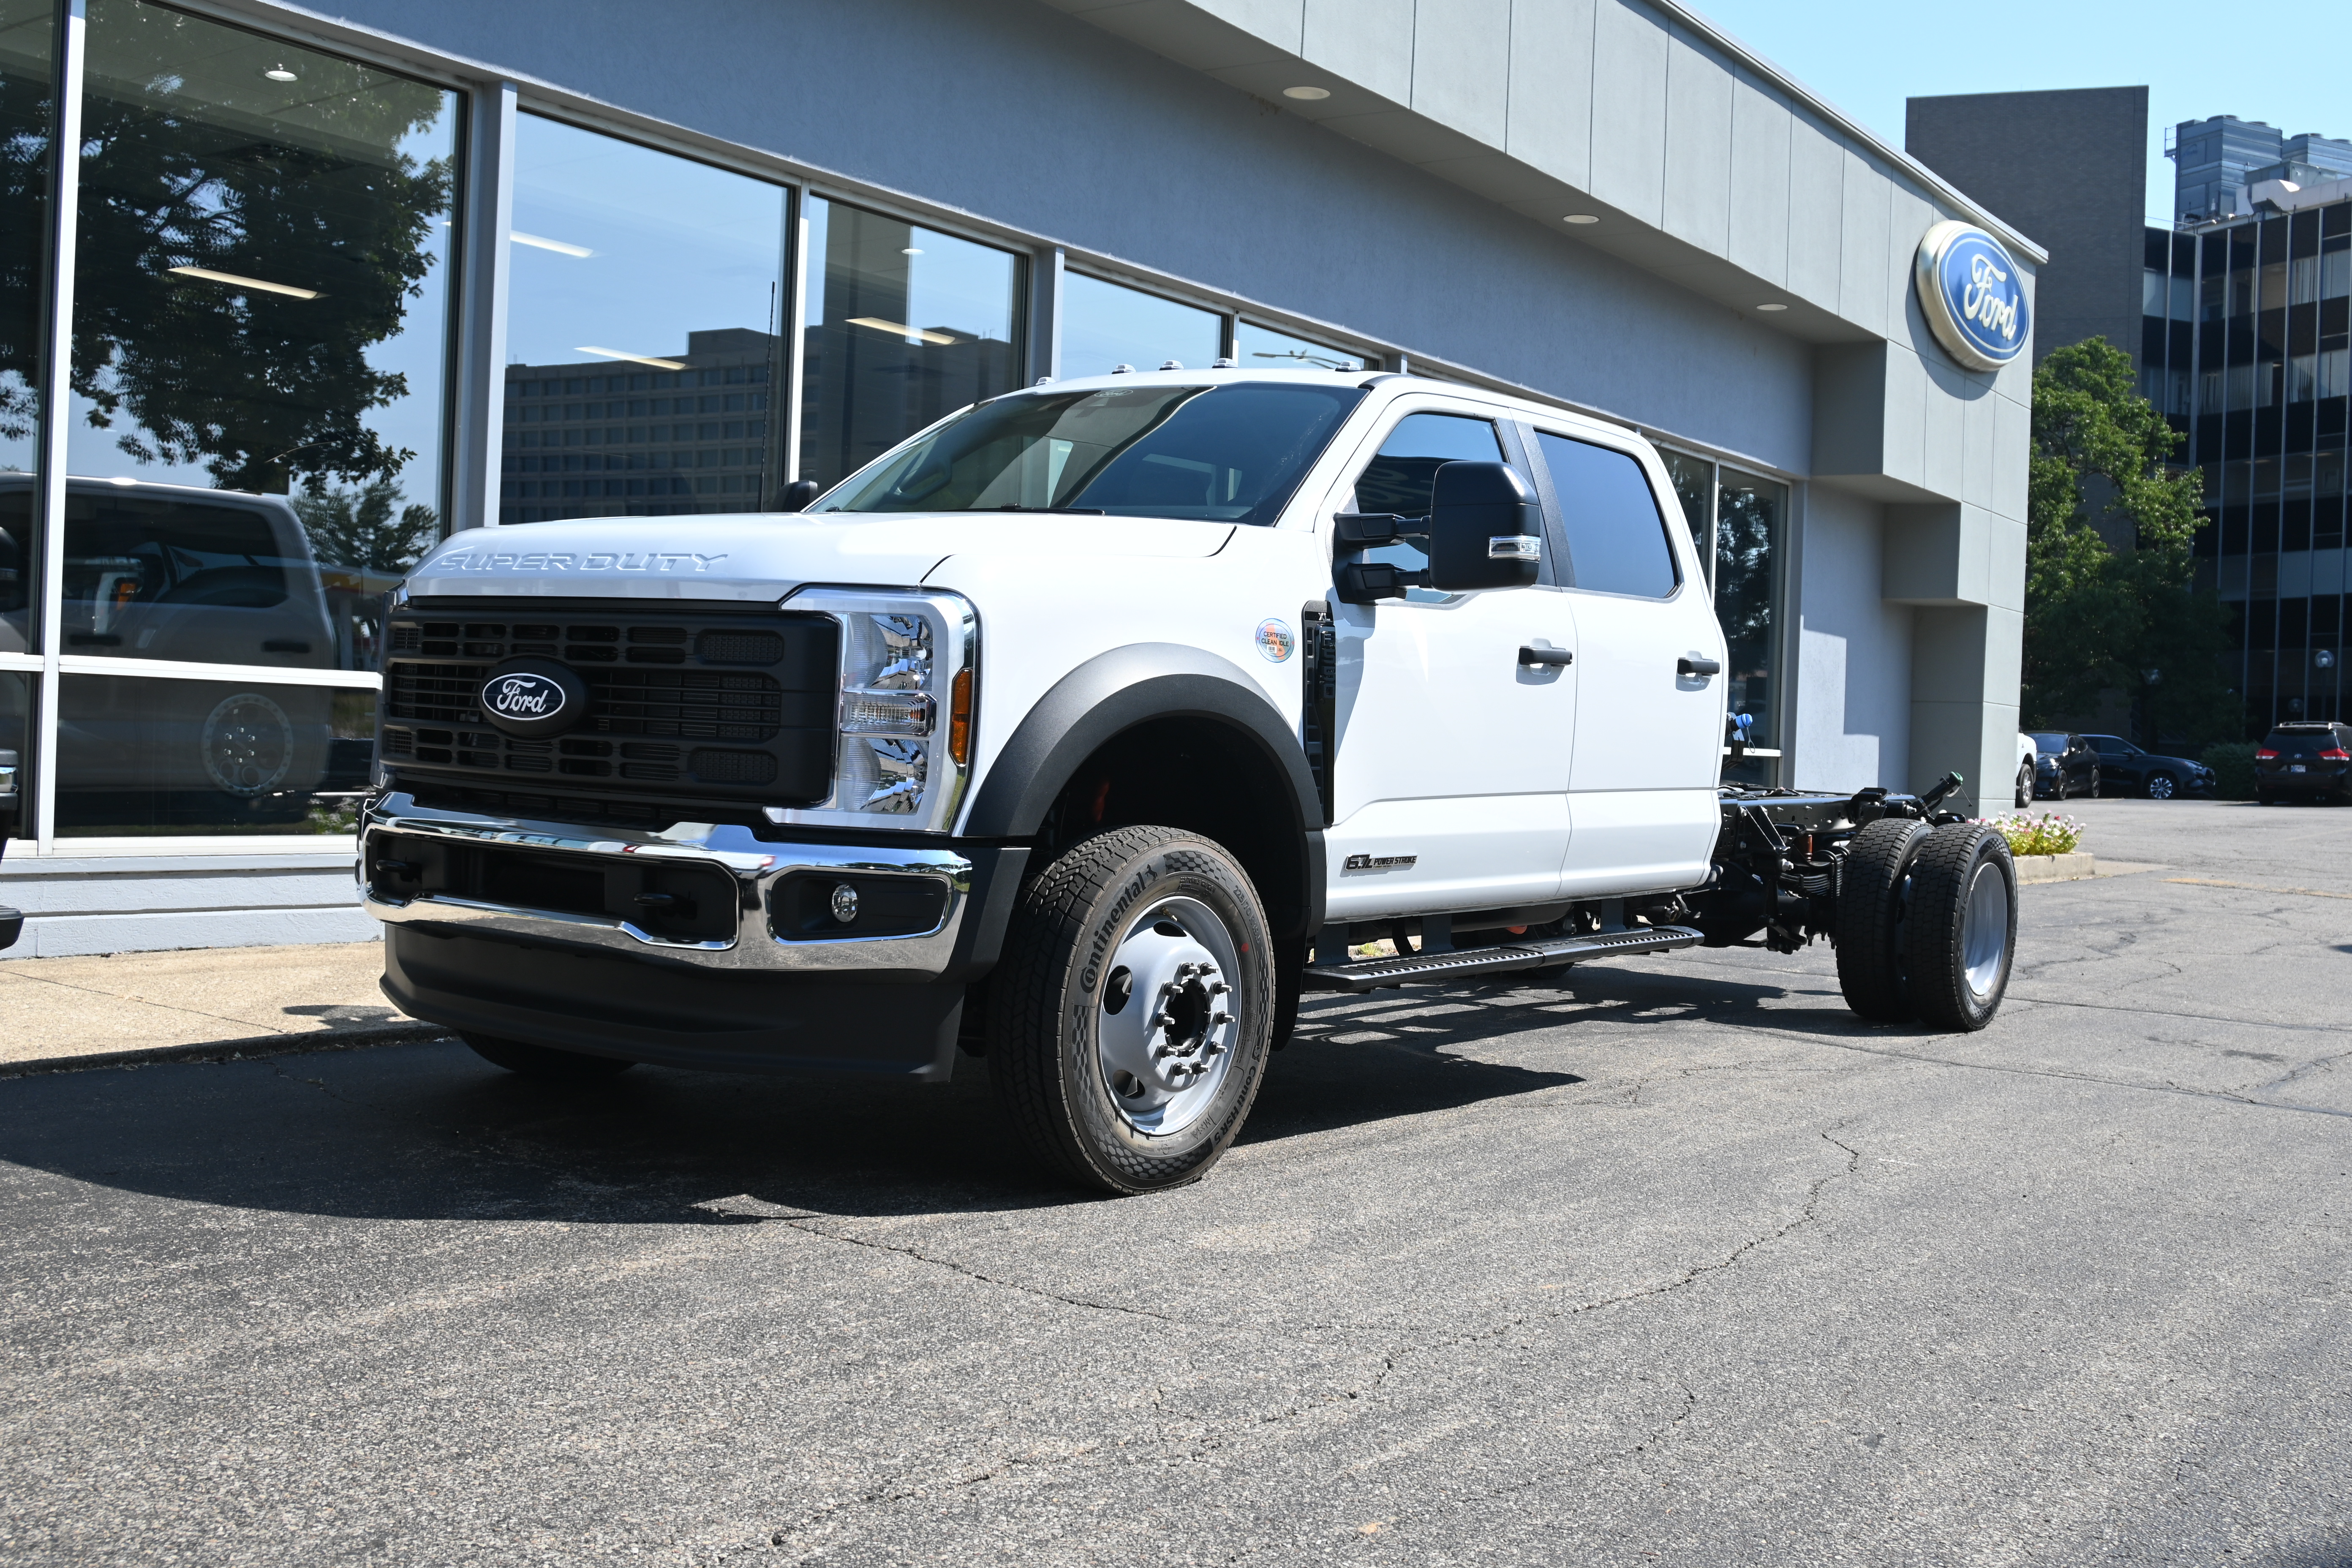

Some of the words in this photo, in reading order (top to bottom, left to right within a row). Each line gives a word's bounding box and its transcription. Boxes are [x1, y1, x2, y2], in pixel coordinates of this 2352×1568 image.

[1964, 253, 2018, 340] Ford
[437, 553, 577, 570] SUPER
[580, 553, 728, 571] DUTY
[1318, 612, 1331, 621] XL
[497, 678, 548, 713] Ford
[1374, 857, 1394, 865] POWER
[1394, 855, 1417, 864] STROKE
[1080, 872, 1146, 994] Continental
[1214, 1132, 1221, 1145] 5
